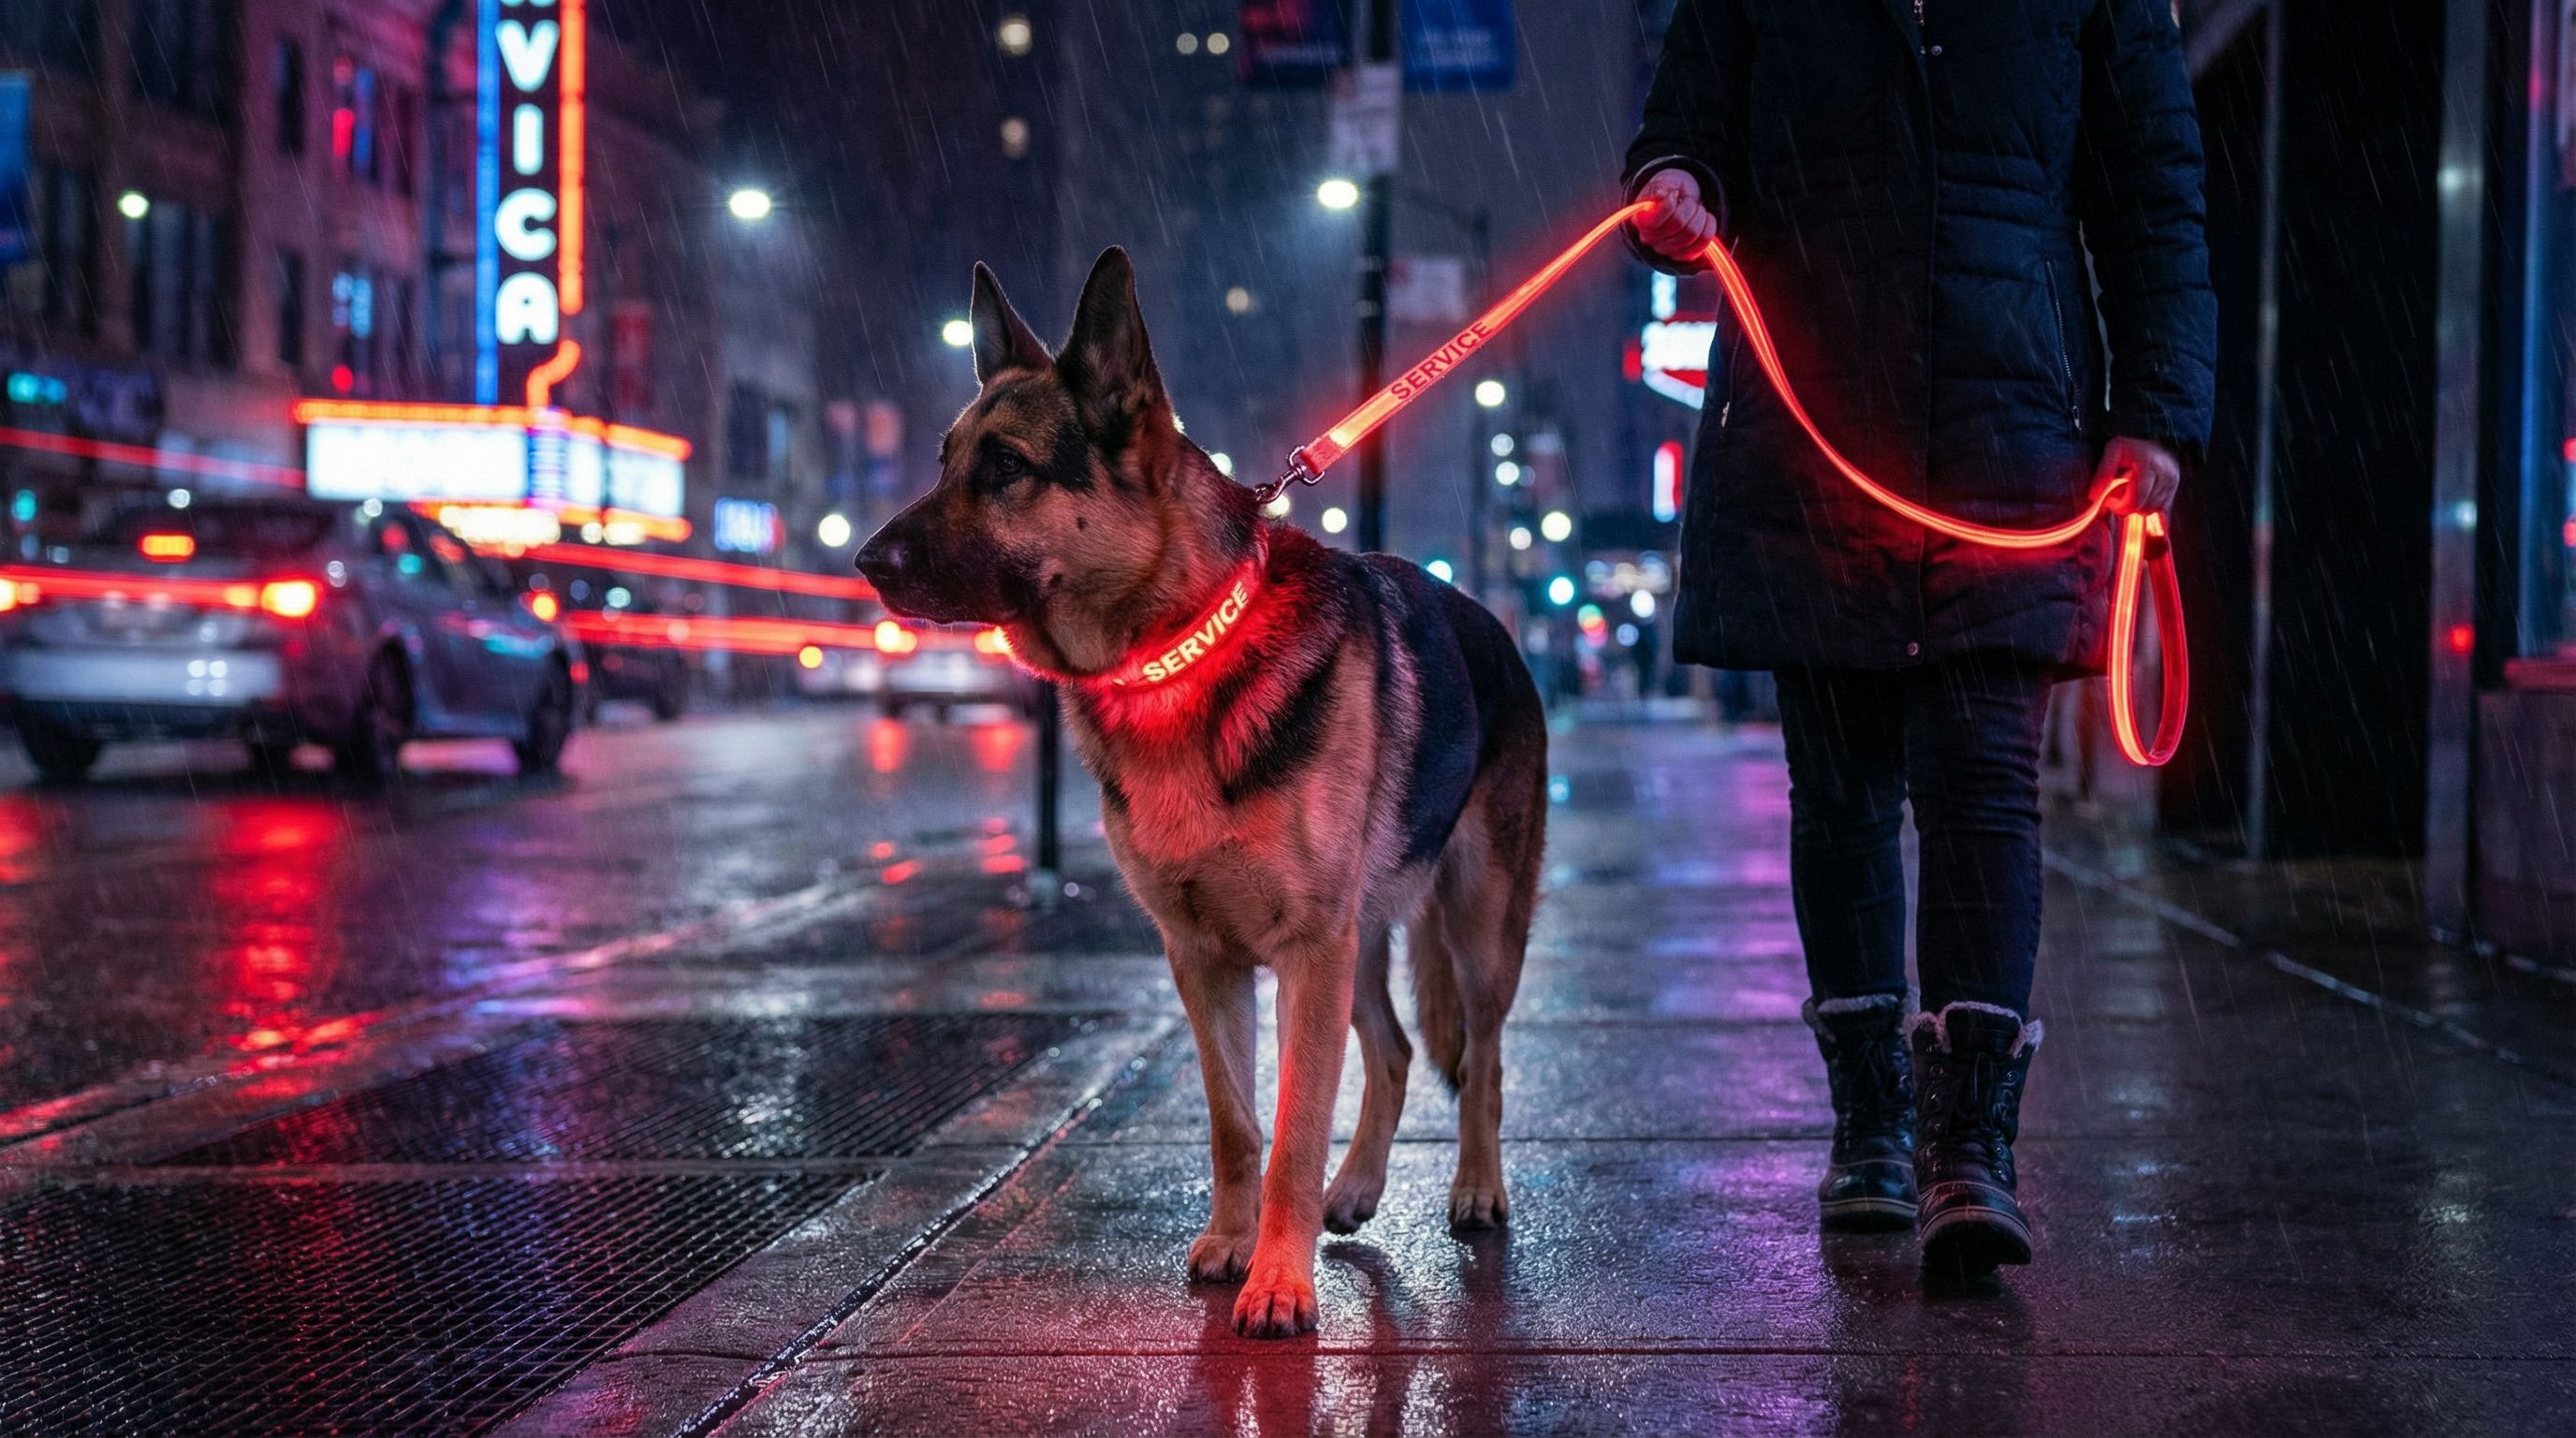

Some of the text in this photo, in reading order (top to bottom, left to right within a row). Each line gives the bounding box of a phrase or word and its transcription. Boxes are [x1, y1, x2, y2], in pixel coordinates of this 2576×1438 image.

[494, 0, 560, 345] VICA
[1391, 322, 1494, 400] SERVICE
[1141, 580, 1250, 682] SERVICE
